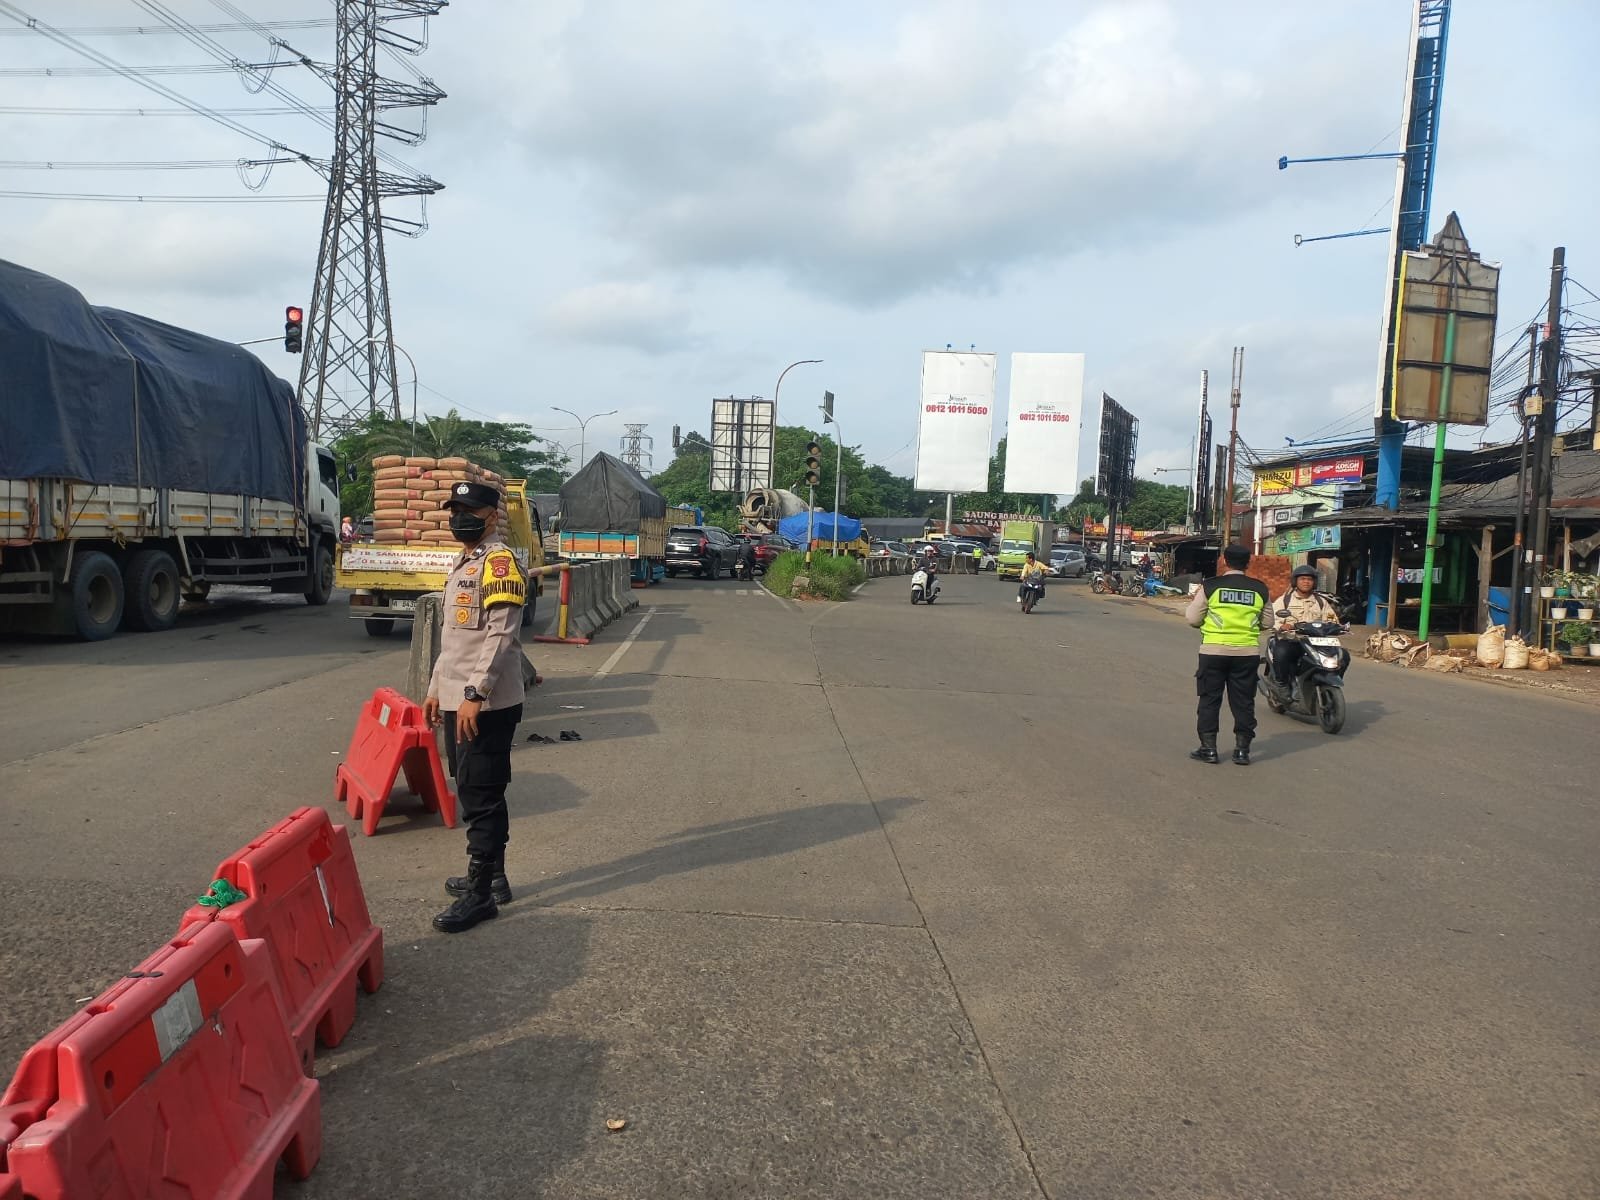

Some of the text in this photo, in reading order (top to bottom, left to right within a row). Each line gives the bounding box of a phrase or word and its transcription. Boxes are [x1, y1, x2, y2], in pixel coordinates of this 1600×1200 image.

[926, 405, 988, 415] 0812 1011 5050
[1019, 413, 1070, 422] 0812 1011 5050
[964, 510, 997, 519] SAUNG
[457, 580, 476, 588] POLRI
[1221, 590, 1254, 606] POLISI
